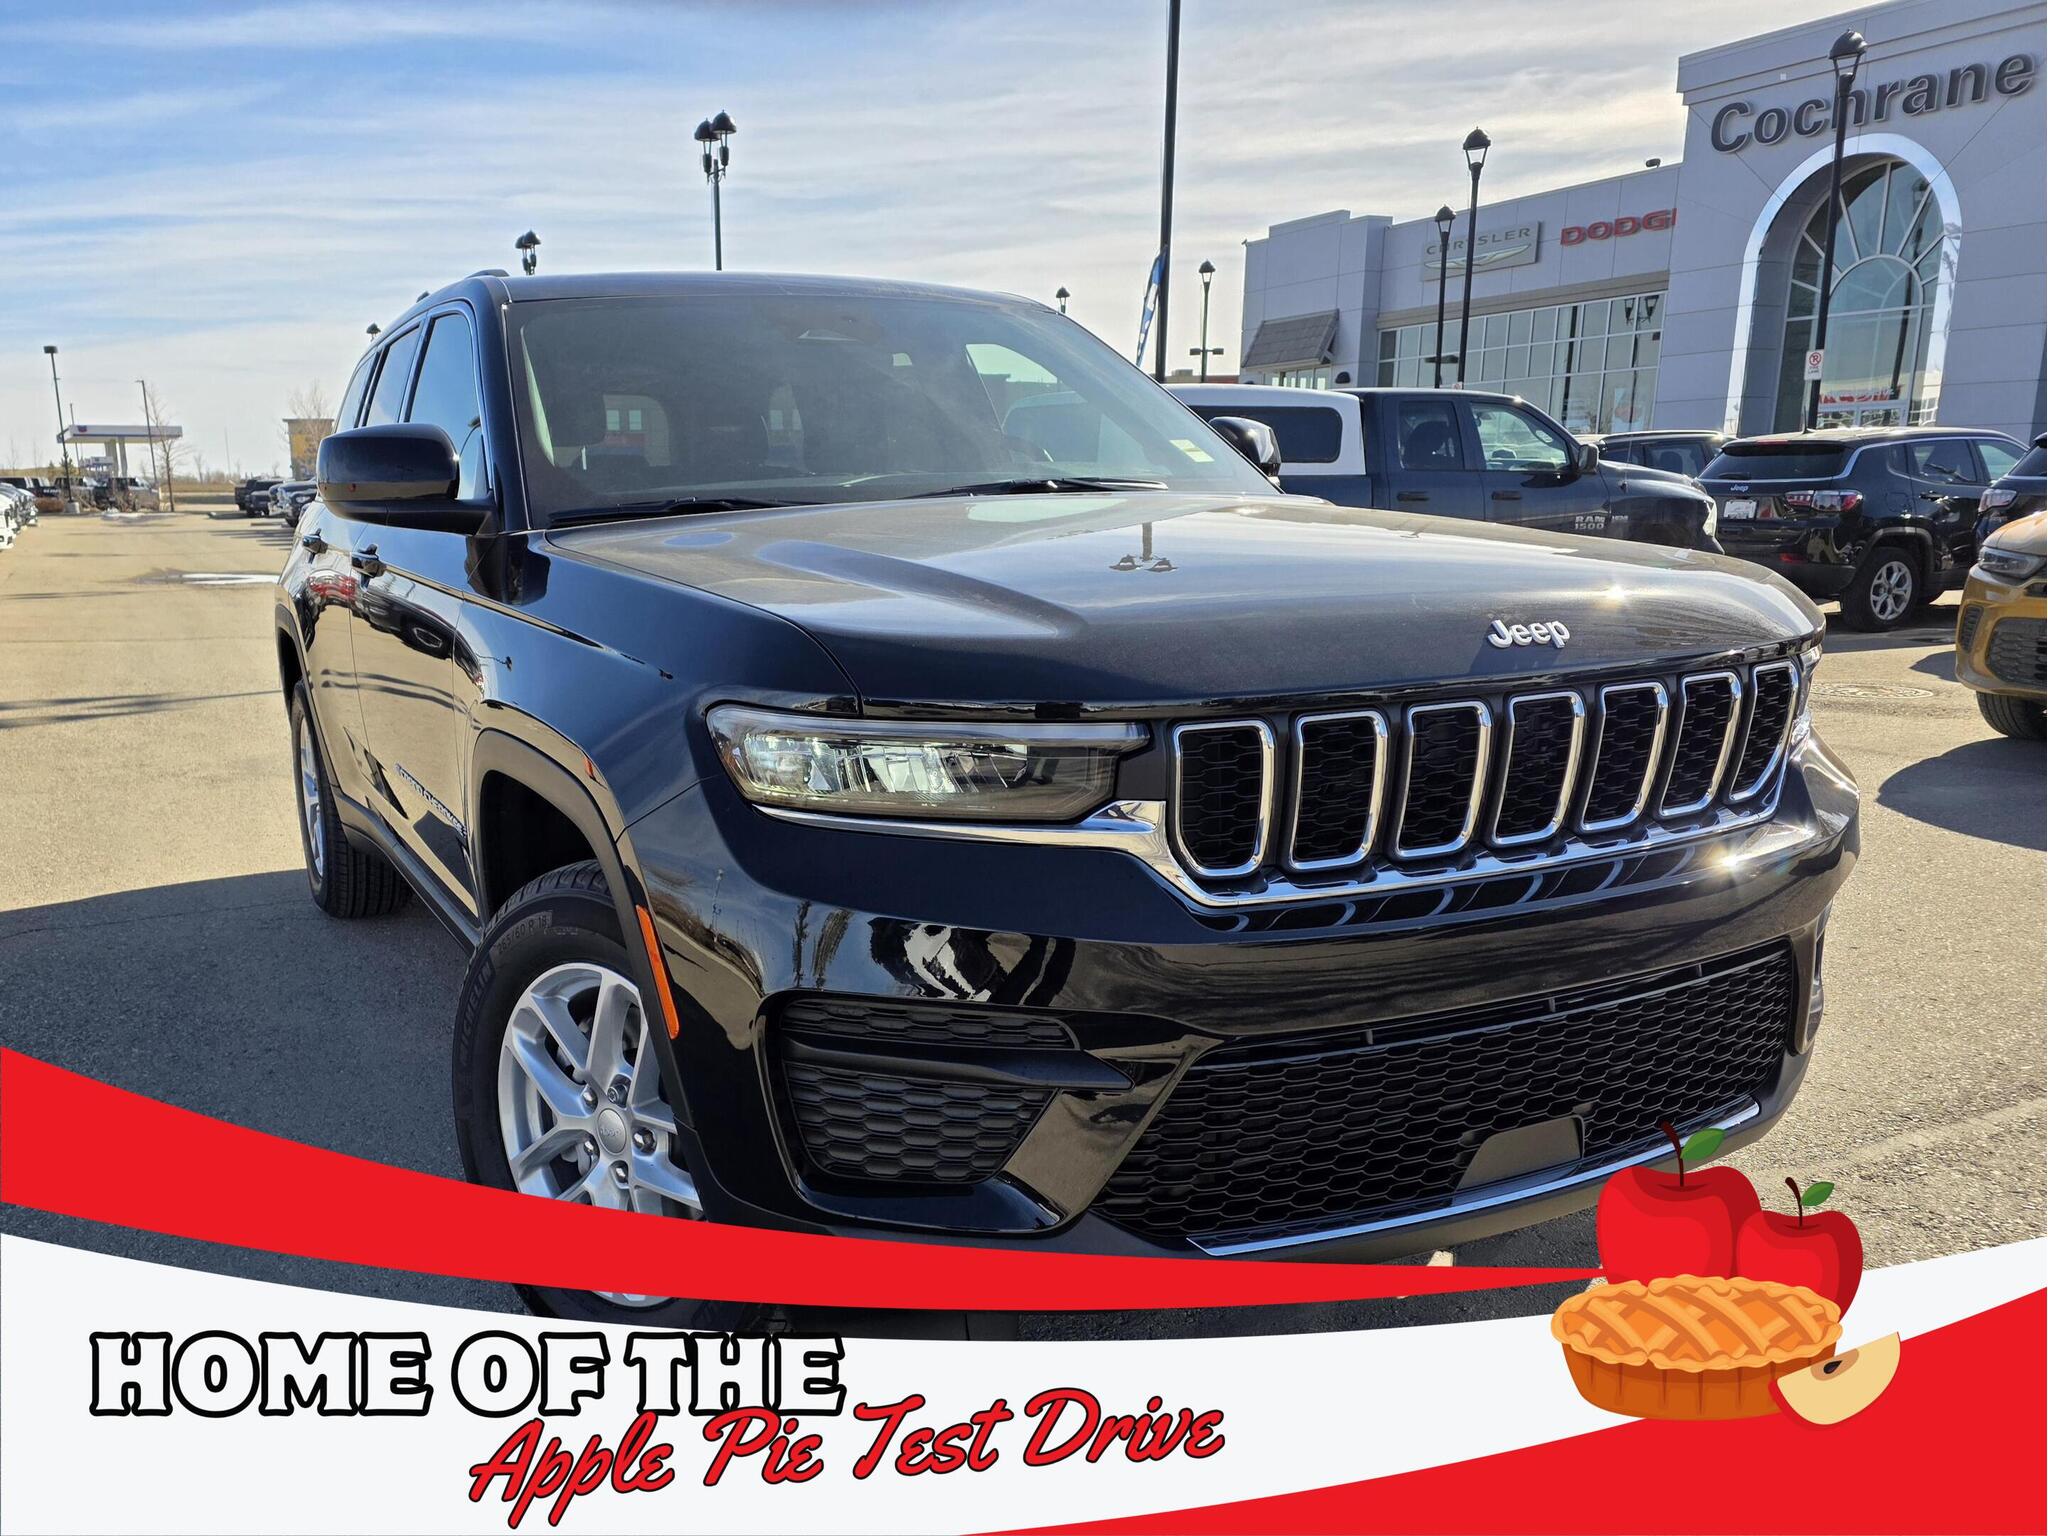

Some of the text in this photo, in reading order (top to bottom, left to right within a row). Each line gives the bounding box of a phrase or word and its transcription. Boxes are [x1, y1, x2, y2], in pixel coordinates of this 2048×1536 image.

[1710, 52, 2036, 153] Cochrane
[1560, 207, 1678, 246] DODG
[1730, 484, 1749, 493] Jeep
[1575, 515, 1606, 523] RAM
[1487, 619, 1571, 649] Jeep
